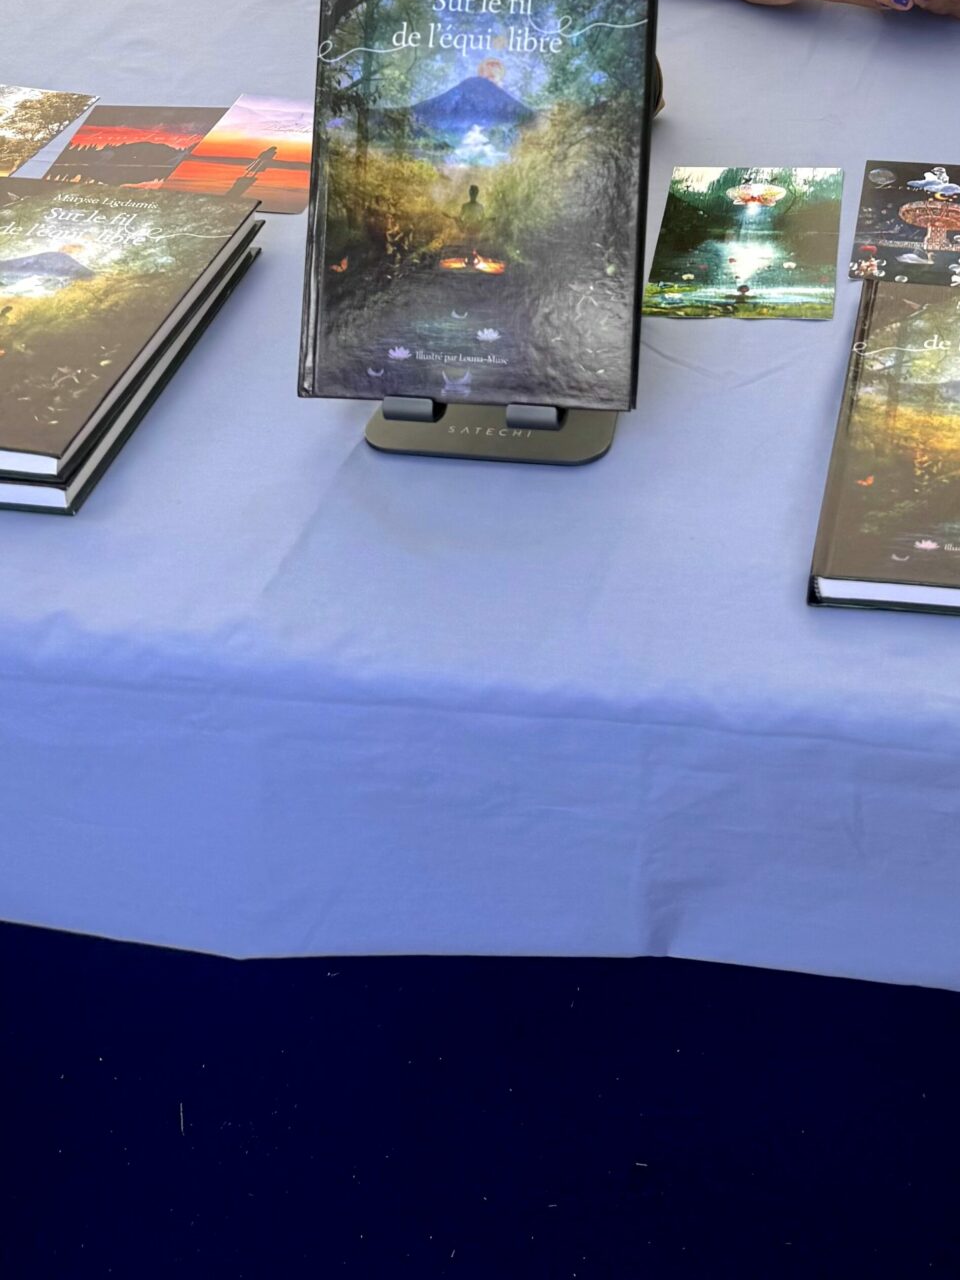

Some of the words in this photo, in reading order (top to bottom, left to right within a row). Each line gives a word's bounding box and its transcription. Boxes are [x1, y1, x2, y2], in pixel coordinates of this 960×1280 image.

[391, 21, 421, 48] de
[508, 26, 563, 53] libre
[53, 193, 100, 206] Maryse
[102, 197, 159, 209] Ligdamis
[44, 207, 85, 221] Sur
[87, 210, 106, 223] le
[110, 213, 137, 226] fil
[923, 334, 951, 350] de
[415, 350, 443, 361] Illustré
[444, 353, 459, 363] par
[448, 425, 532, 438] SATECHI
